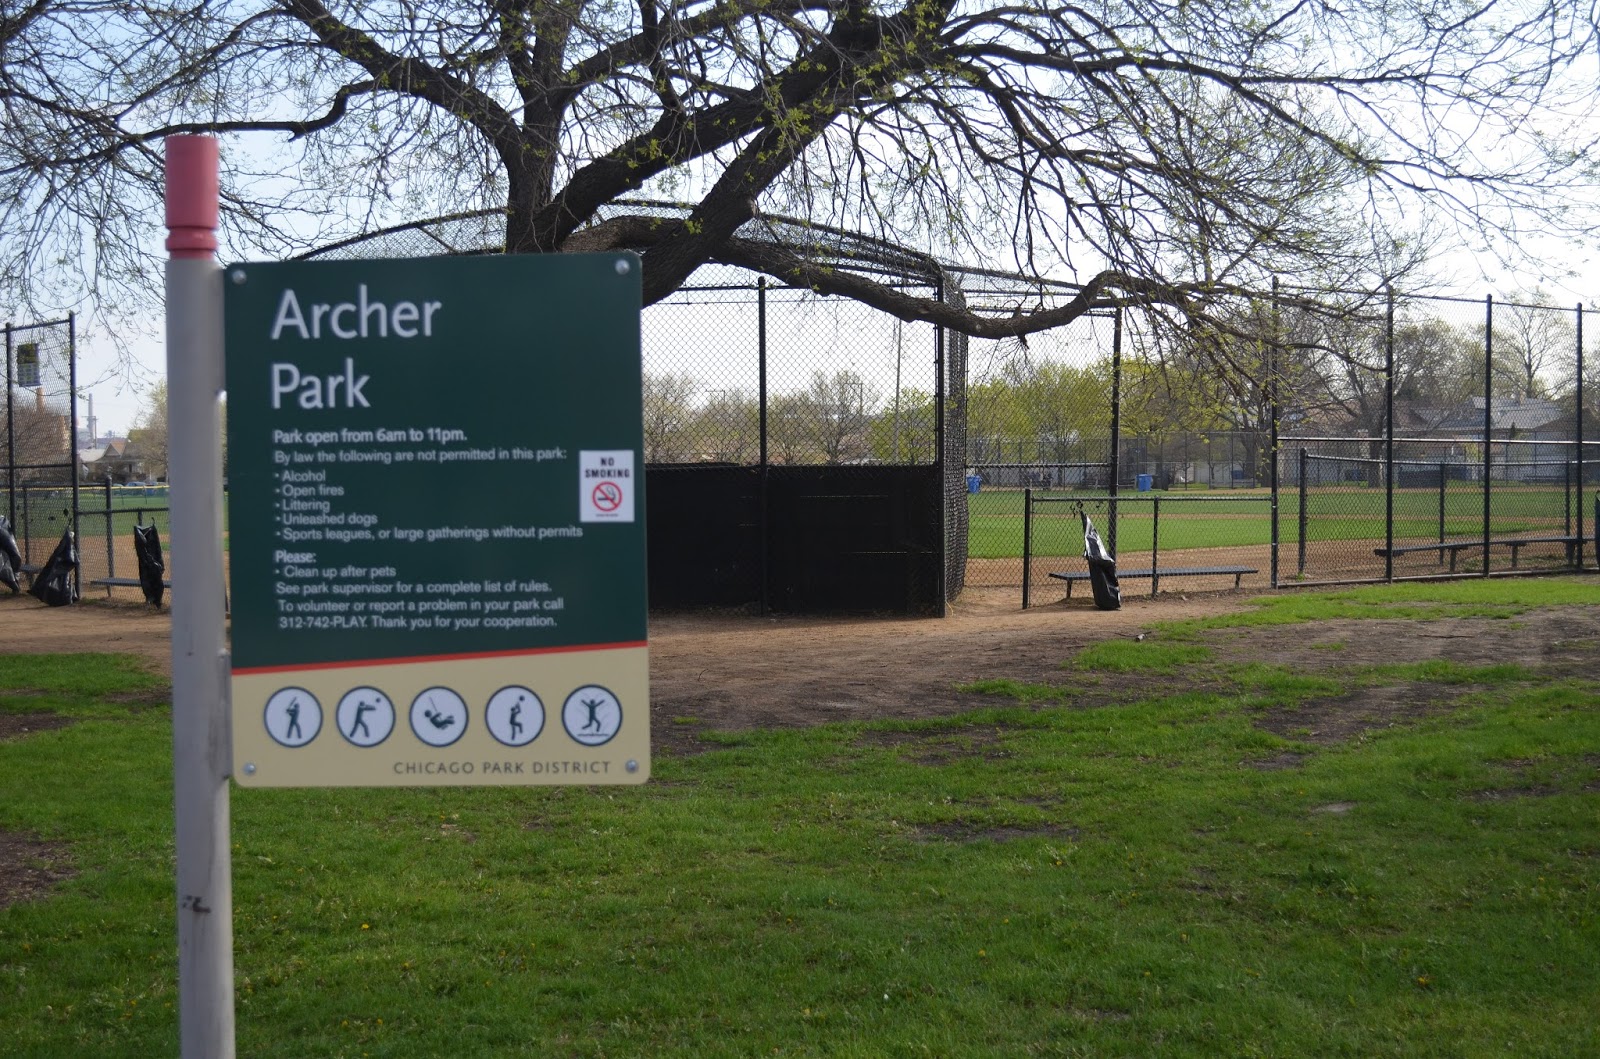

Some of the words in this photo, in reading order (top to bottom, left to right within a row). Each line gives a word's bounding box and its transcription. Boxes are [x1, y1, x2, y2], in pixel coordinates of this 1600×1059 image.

[271, 284, 442, 340] Archer
[271, 357, 371, 409] Park
[273, 429, 303, 444] Park
[305, 432, 338, 446] open
[340, 428, 373, 442] from
[375, 428, 406, 442] 6am
[409, 428, 424, 441] to
[427, 428, 467, 444] 11pm.
[274, 450, 291, 466] By
[293, 451, 314, 462] law
[317, 450, 336, 462] the
[338, 450, 392, 464] following
[394, 452, 414, 461] are
[417, 450, 436, 461] not
[439, 448, 495, 463] permitted
[498, 448, 509, 459] in
[512, 447, 534, 459] this
[536, 447, 566, 462] park:
[601, 457, 615, 466] NO
[282, 470, 326, 482] Alcohol
[585, 468, 630, 478] SMOKING
[282, 484, 316, 498] Open
[318, 484, 344, 496] fires
[282, 499, 330, 513] Littering
[282, 513, 345, 525] Unleashed
[347, 512, 378, 526] dogs
[282, 527, 323, 542] Sports
[325, 527, 374, 541] leagues,
[378, 530, 391, 539] or
[394, 527, 424, 541] large
[426, 526, 489, 540] gatherings
[491, 526, 535, 538] without
[538, 525, 583, 539] permits
[275, 550, 316, 563] Please:
[283, 565, 319, 578] Clean
[322, 568, 338, 580] up
[340, 565, 367, 577] after
[370, 566, 396, 579] pets
[276, 581, 300, 594] See
[302, 582, 329, 596] park
[332, 582, 393, 596] supervisor
[396, 581, 413, 593] for
[415, 584, 424, 593] a
[426, 581, 481, 595] complete
[484, 580, 501, 592] list
[504, 580, 516, 592] of
[519, 580, 552, 592] rules.
[278, 599, 294, 612] To
[296, 600, 350, 612] volunteer
[352, 602, 366, 612] or
[368, 600, 405, 613] report
[408, 602, 416, 611] a
[418, 599, 467, 613] problem
[470, 599, 481, 610] in
[484, 601, 510, 613] your
[513, 598, 540, 612] park
[542, 597, 564, 610] call
[280, 615, 367, 628] 312-742-PLAY.
[371, 615, 407, 628] Thank
[410, 618, 432, 630] you
[434, 615, 451, 627] for
[454, 618, 480, 630] your
[483, 615, 557, 630] cooperation.
[393, 762, 475, 774] CHICAGO
[482, 761, 525, 774] PARK
[532, 760, 612, 774] DISTRICT
